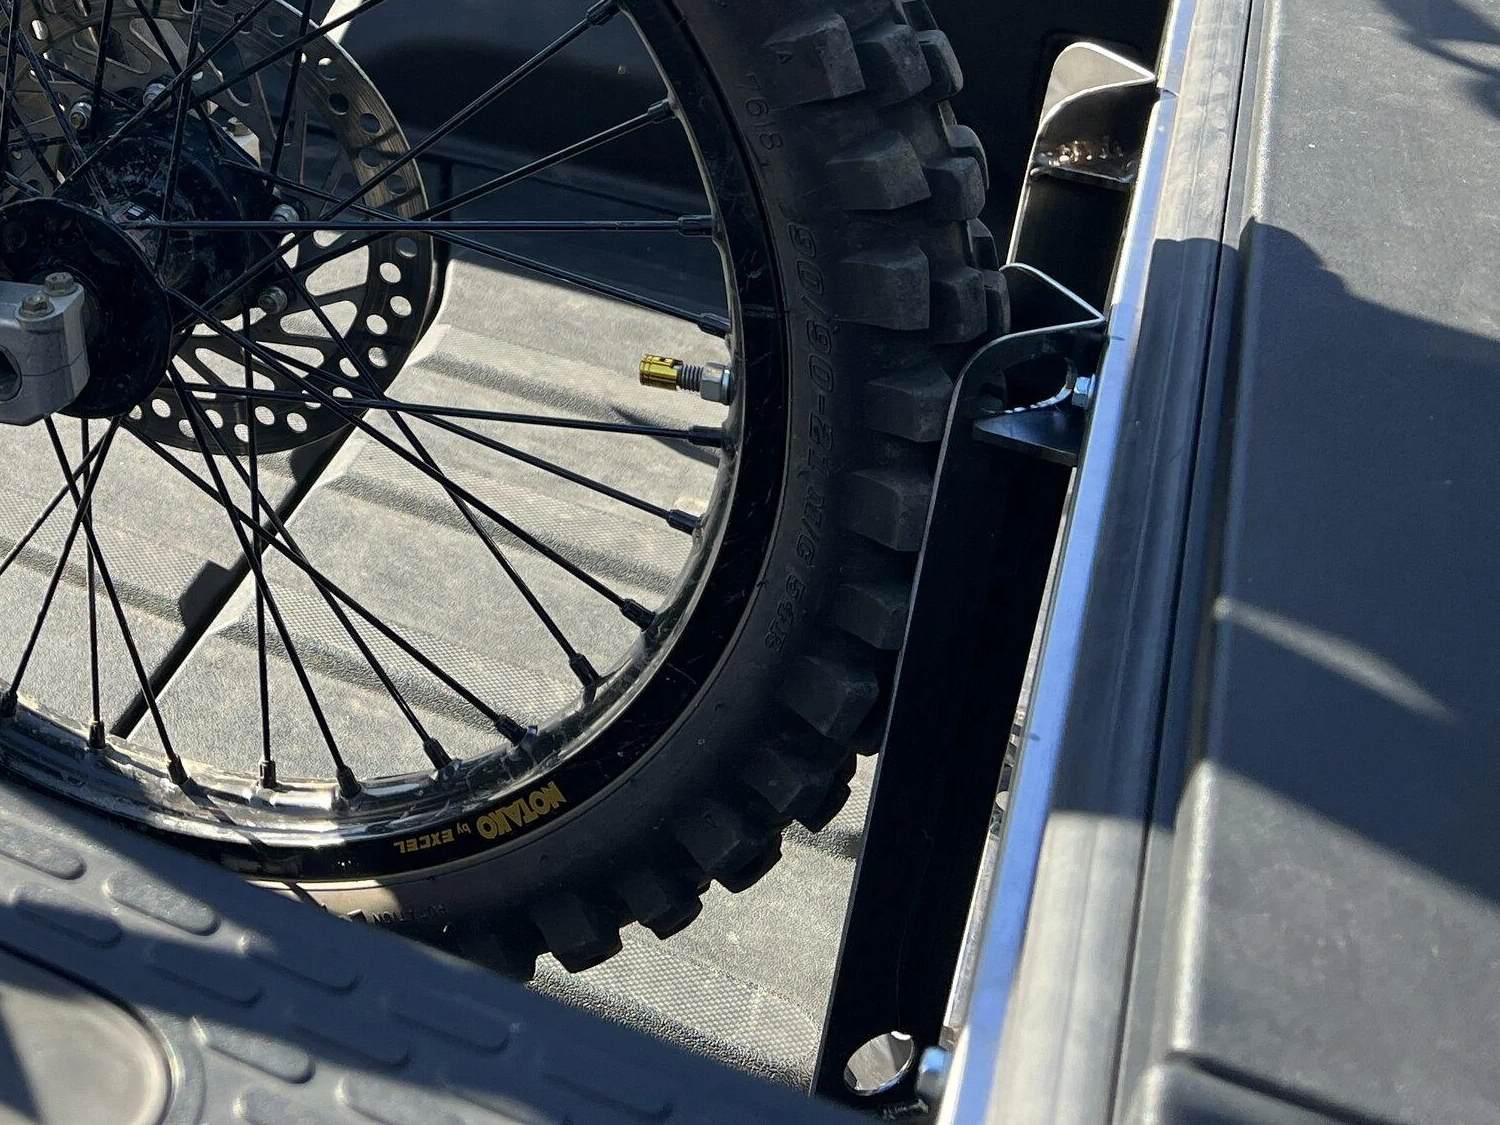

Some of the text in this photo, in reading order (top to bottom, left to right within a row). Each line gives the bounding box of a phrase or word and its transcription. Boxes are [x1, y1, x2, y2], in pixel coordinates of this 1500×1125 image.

[788, 222, 834, 478] 90/90-21
[393, 781, 567, 854] NOTAKO by EXCEL
